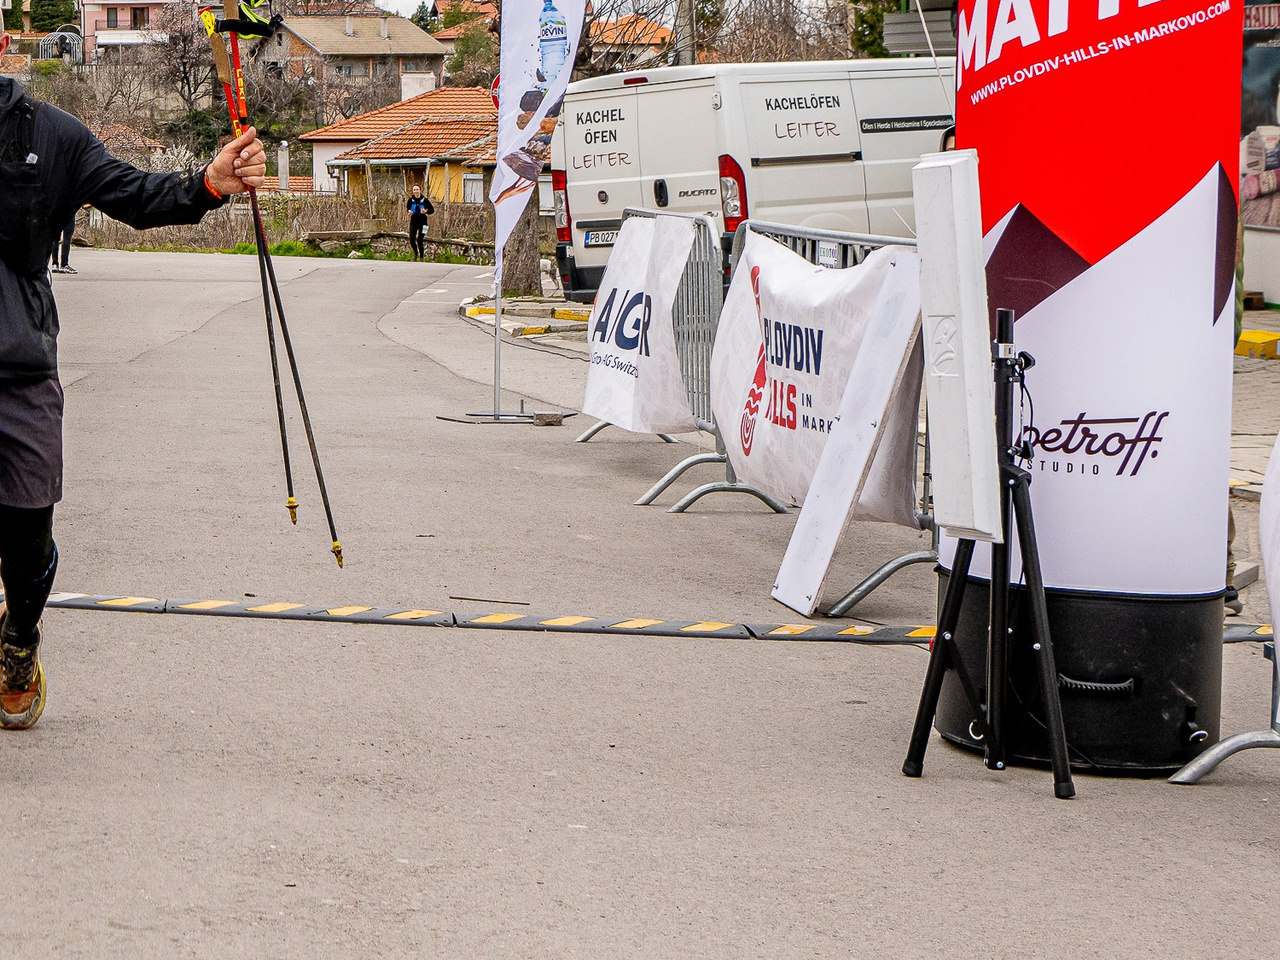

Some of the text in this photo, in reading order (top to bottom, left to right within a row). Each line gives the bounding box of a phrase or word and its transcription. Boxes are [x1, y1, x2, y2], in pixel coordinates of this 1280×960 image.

[541, 24, 564, 38] DEVIN
[236, 68, 246, 100] LEKI
[765, 93, 841, 111] KACHELÖFEN
[576, 108, 625, 125] KACHEL
[233, 119, 243, 139] LE
[584, 129, 617, 145] ÖFEN
[774, 121, 841, 139] LEITER
[572, 152, 632, 170] LEITER
[678, 188, 717, 198] DUCATO
[590, 233, 600, 244] PB
[763, 317, 824, 376] PLOVDIV
[765, 377, 797, 431] ILLS
[801, 392, 812, 408] IN
[802, 414, 834, 434] MARK
[1026, 459, 1100, 476] STUDIO
